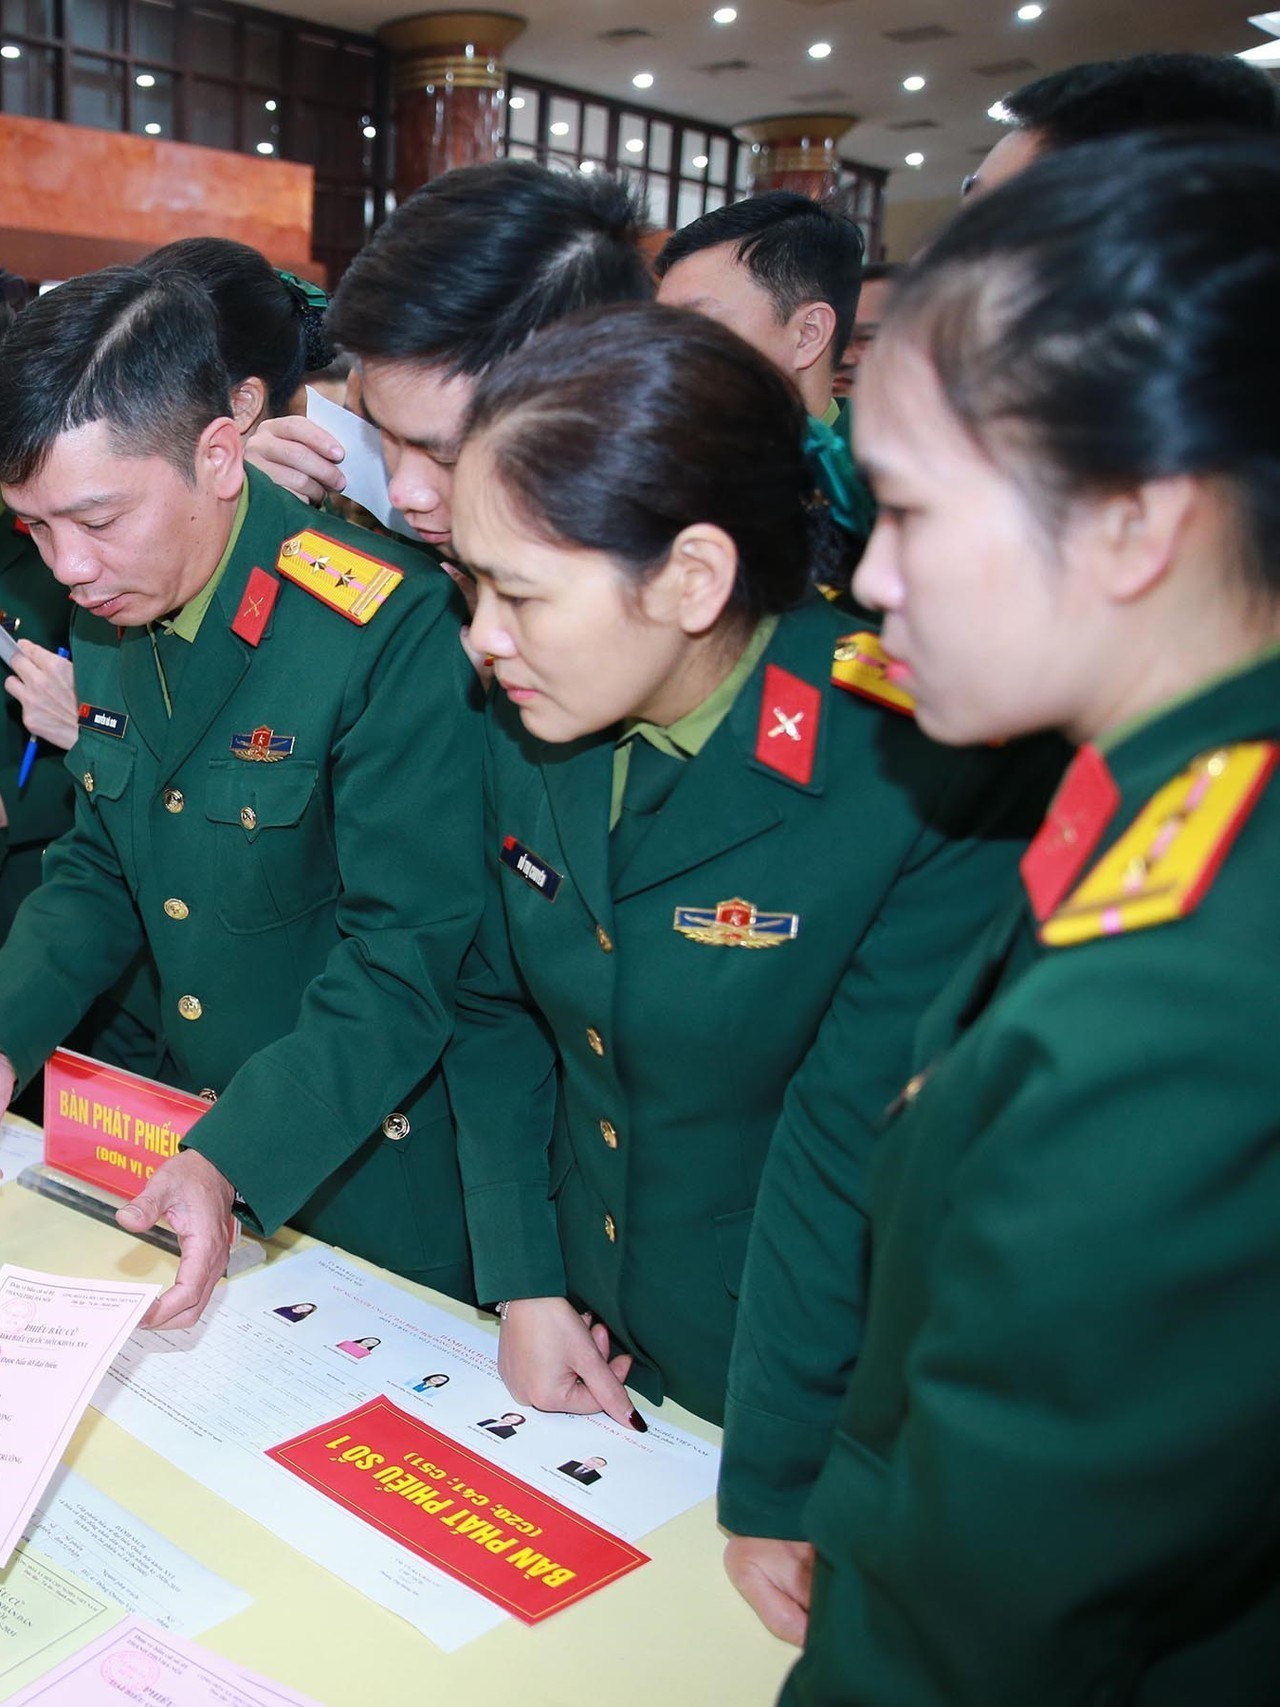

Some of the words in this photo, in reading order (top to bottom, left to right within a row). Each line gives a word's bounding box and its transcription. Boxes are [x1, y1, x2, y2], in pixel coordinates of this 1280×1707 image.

[59, 1088, 89, 1126] BÀN
[92, 1102, 131, 1142] PHÁT
[96, 1145, 127, 1169] (ĐƠN
[130, 1158, 142, 1179] VỊ
[325, 1433, 352, 1451] 1
[329, 1443, 386, 1473] SỐ
[371, 1465, 456, 1516] PHIẾU
[439, 1506, 520, 1555] PHÁT
[504, 1545, 578, 1589] BÀN
[8, 1597, 25, 1606] CỬ
